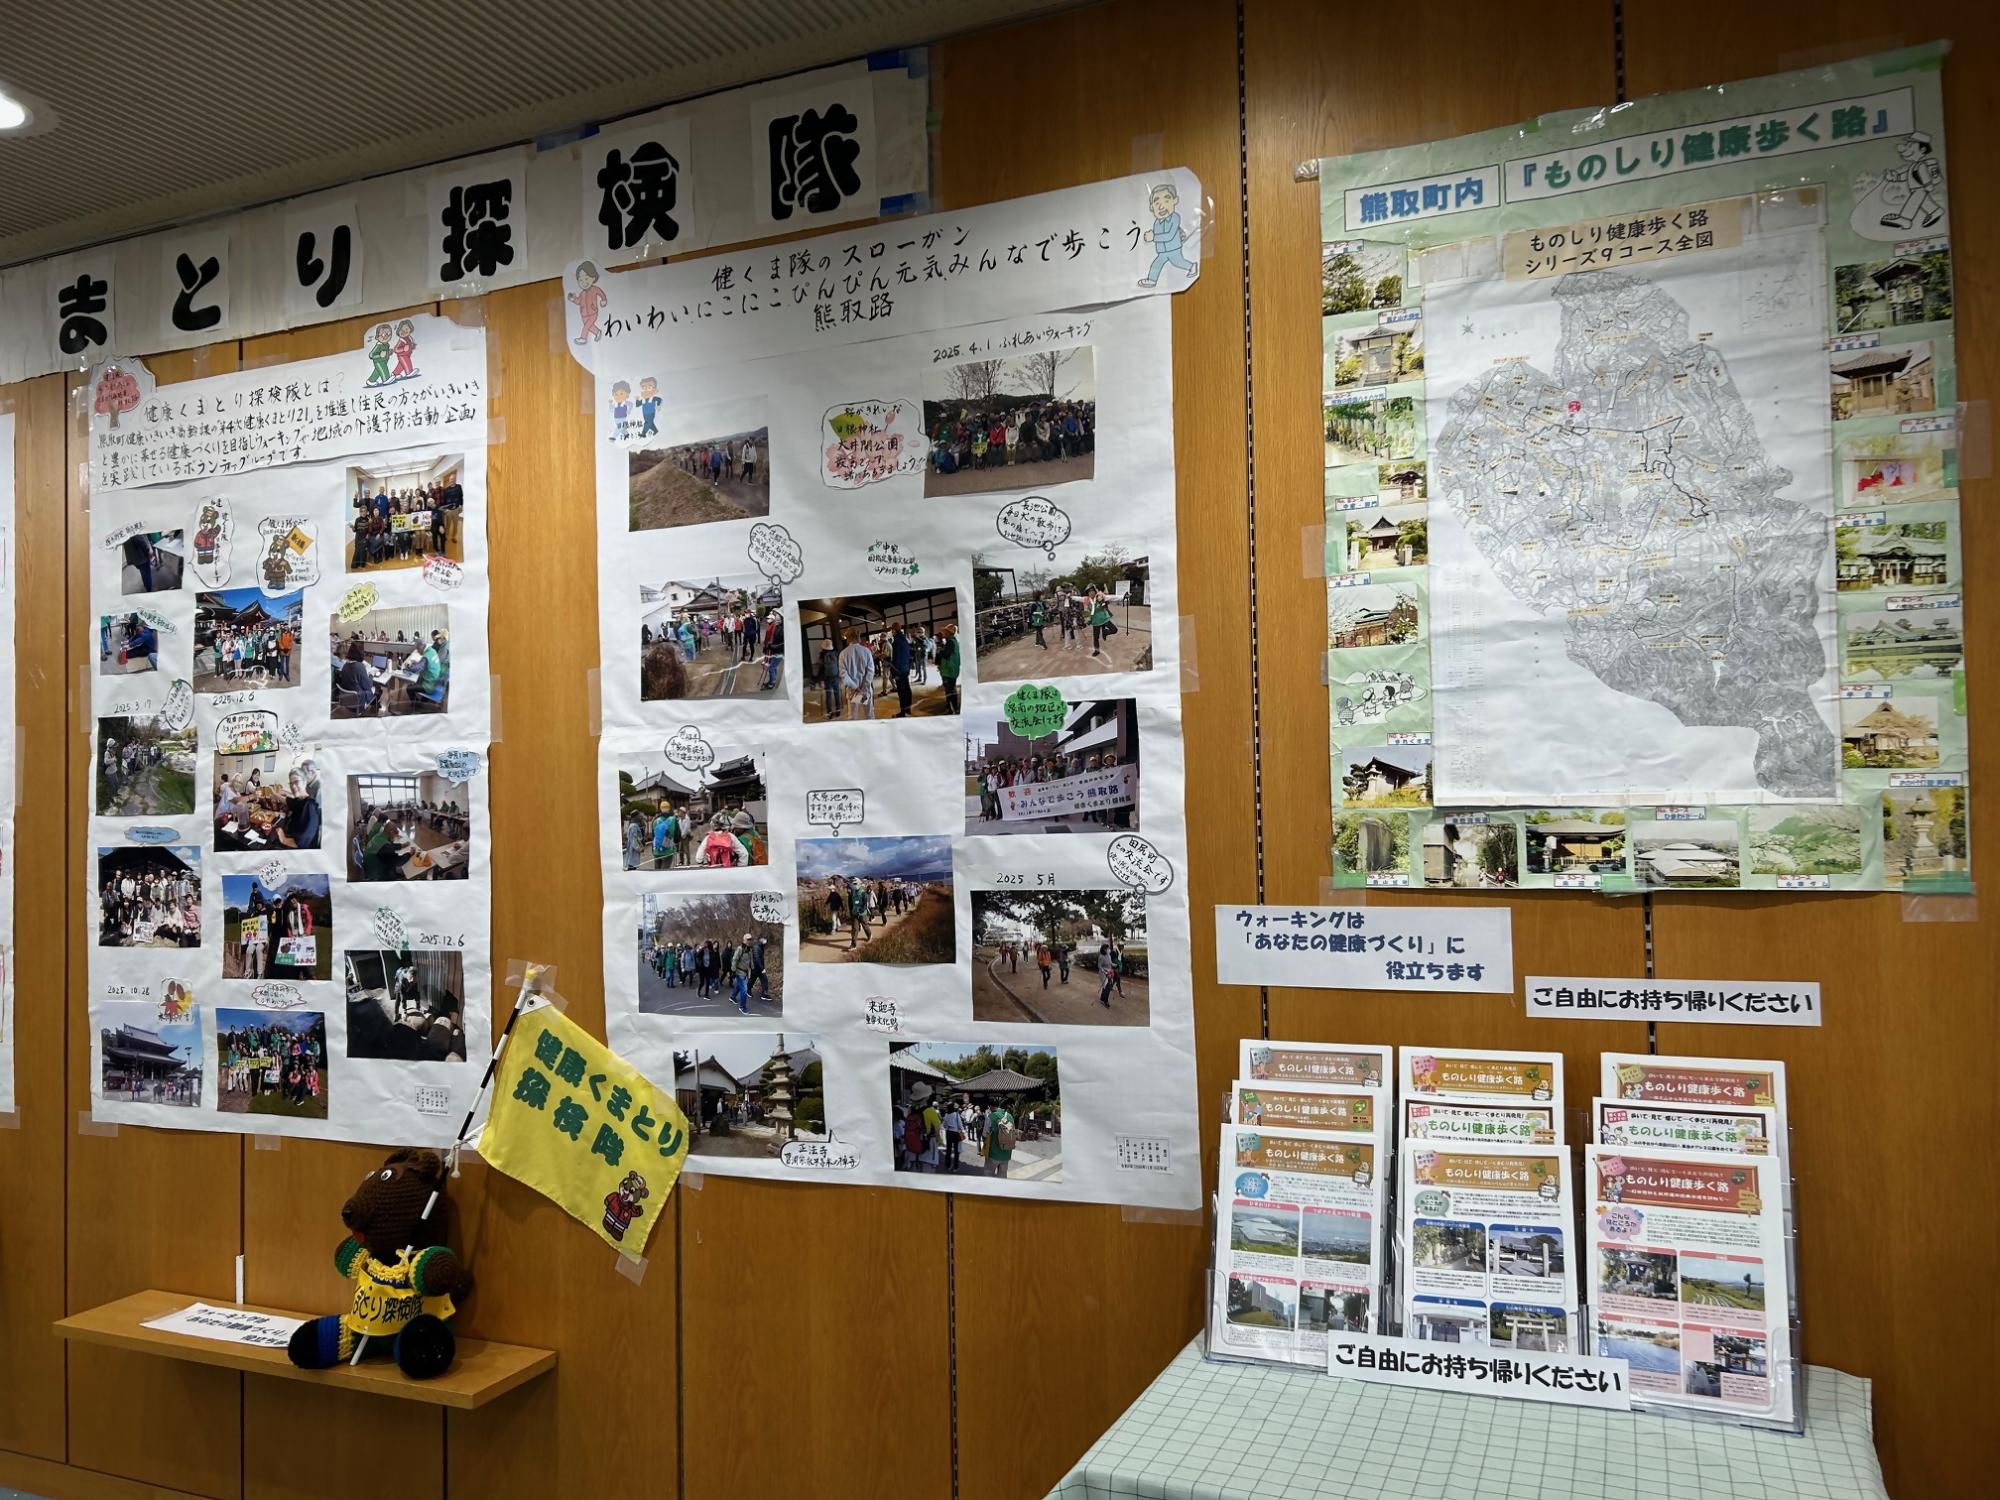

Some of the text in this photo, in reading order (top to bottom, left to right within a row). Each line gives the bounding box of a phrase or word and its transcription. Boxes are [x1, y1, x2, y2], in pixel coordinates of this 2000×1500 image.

[1522, 104, 1890, 188] 『ものしり健康歩く路』
[1358, 177, 1486, 224] 熊取町内
[1528, 207, 1711, 253] ものしり健康歩く路
[711, 226, 971, 293] 健くま隊のスローガン
[813, 291, 895, 333] 熊取路
[1235, 911, 1365, 929] ウォーキングは
[1244, 933, 1466, 955] 「あなたの健康づくり」に
[1385, 960, 1486, 983] 役立ちます
[1532, 986, 1813, 1013] ご自由にお持ち帰りください
[534, 1028, 684, 1157] 健康くまとり
[1644, 1080, 1746, 1098] ものしり健康歩く路
[512, 1066, 626, 1167] 探検隊
[1265, 1102, 1347, 1117] ものしり健康歩く路
[1428, 1119, 1531, 1137] ものしり健康歩く路
[1628, 1125, 1738, 1143] ものしり健康歩く路
[798, 1143, 828, 1158] 正法寺
[1265, 1148, 1345, 1165] ものしり健康歩く路
[1625, 1174, 1730, 1194] ものしり健康歩く路
[1334, 1342, 1623, 1393] ご自由にお持ち帰りください
